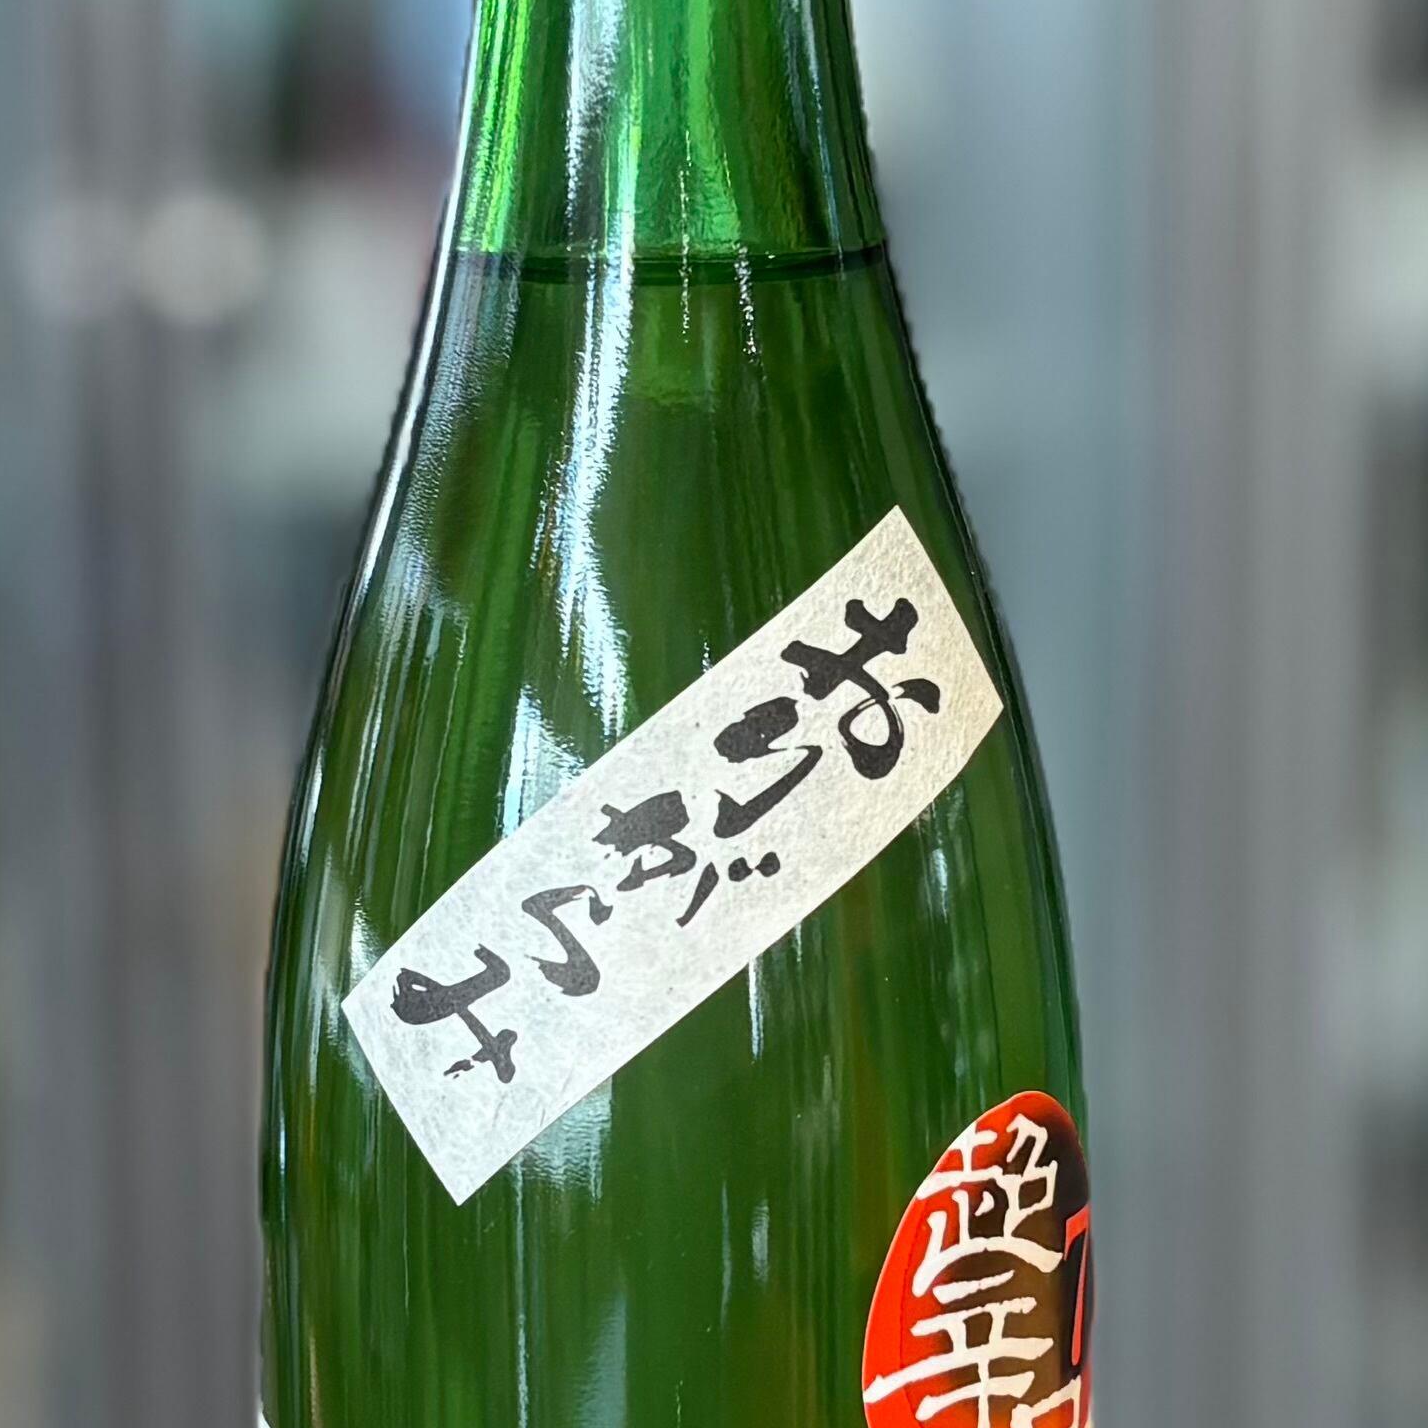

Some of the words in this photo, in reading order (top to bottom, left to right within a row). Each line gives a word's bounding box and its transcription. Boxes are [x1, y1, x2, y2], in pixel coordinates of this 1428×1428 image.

[390, 597, 941, 1085] おりがらみ
